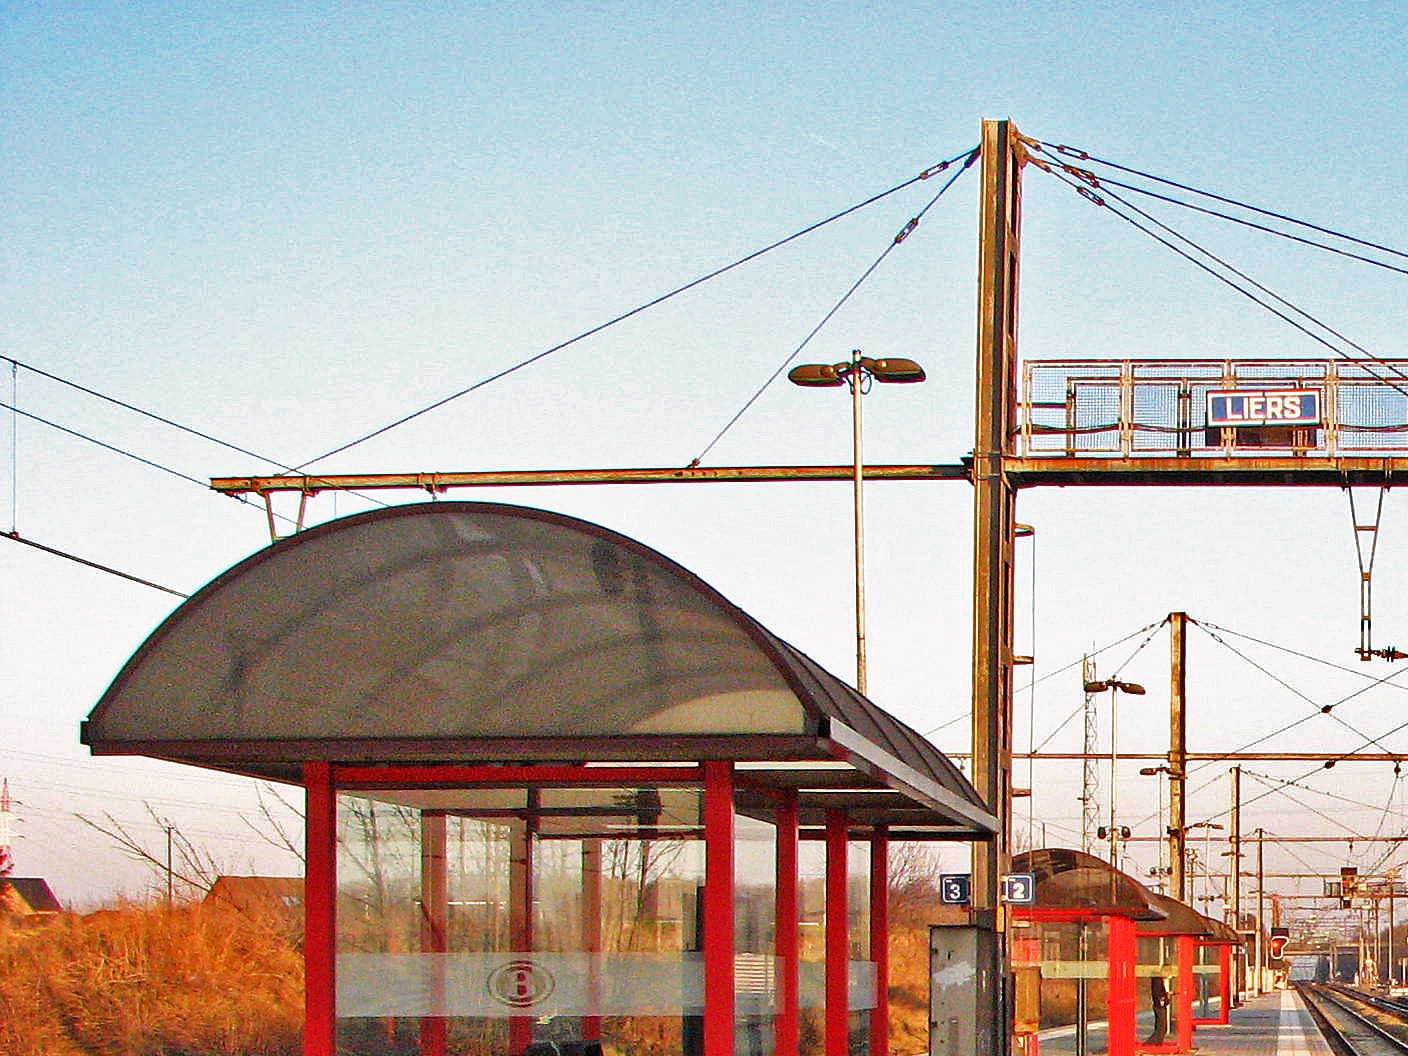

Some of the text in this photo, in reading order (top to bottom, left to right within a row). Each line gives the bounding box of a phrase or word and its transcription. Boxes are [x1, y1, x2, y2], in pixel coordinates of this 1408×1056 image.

[1225, 396, 1301, 419] LIERS
[949, 883, 961, 900] 3
[1012, 882, 1024, 899] 2
